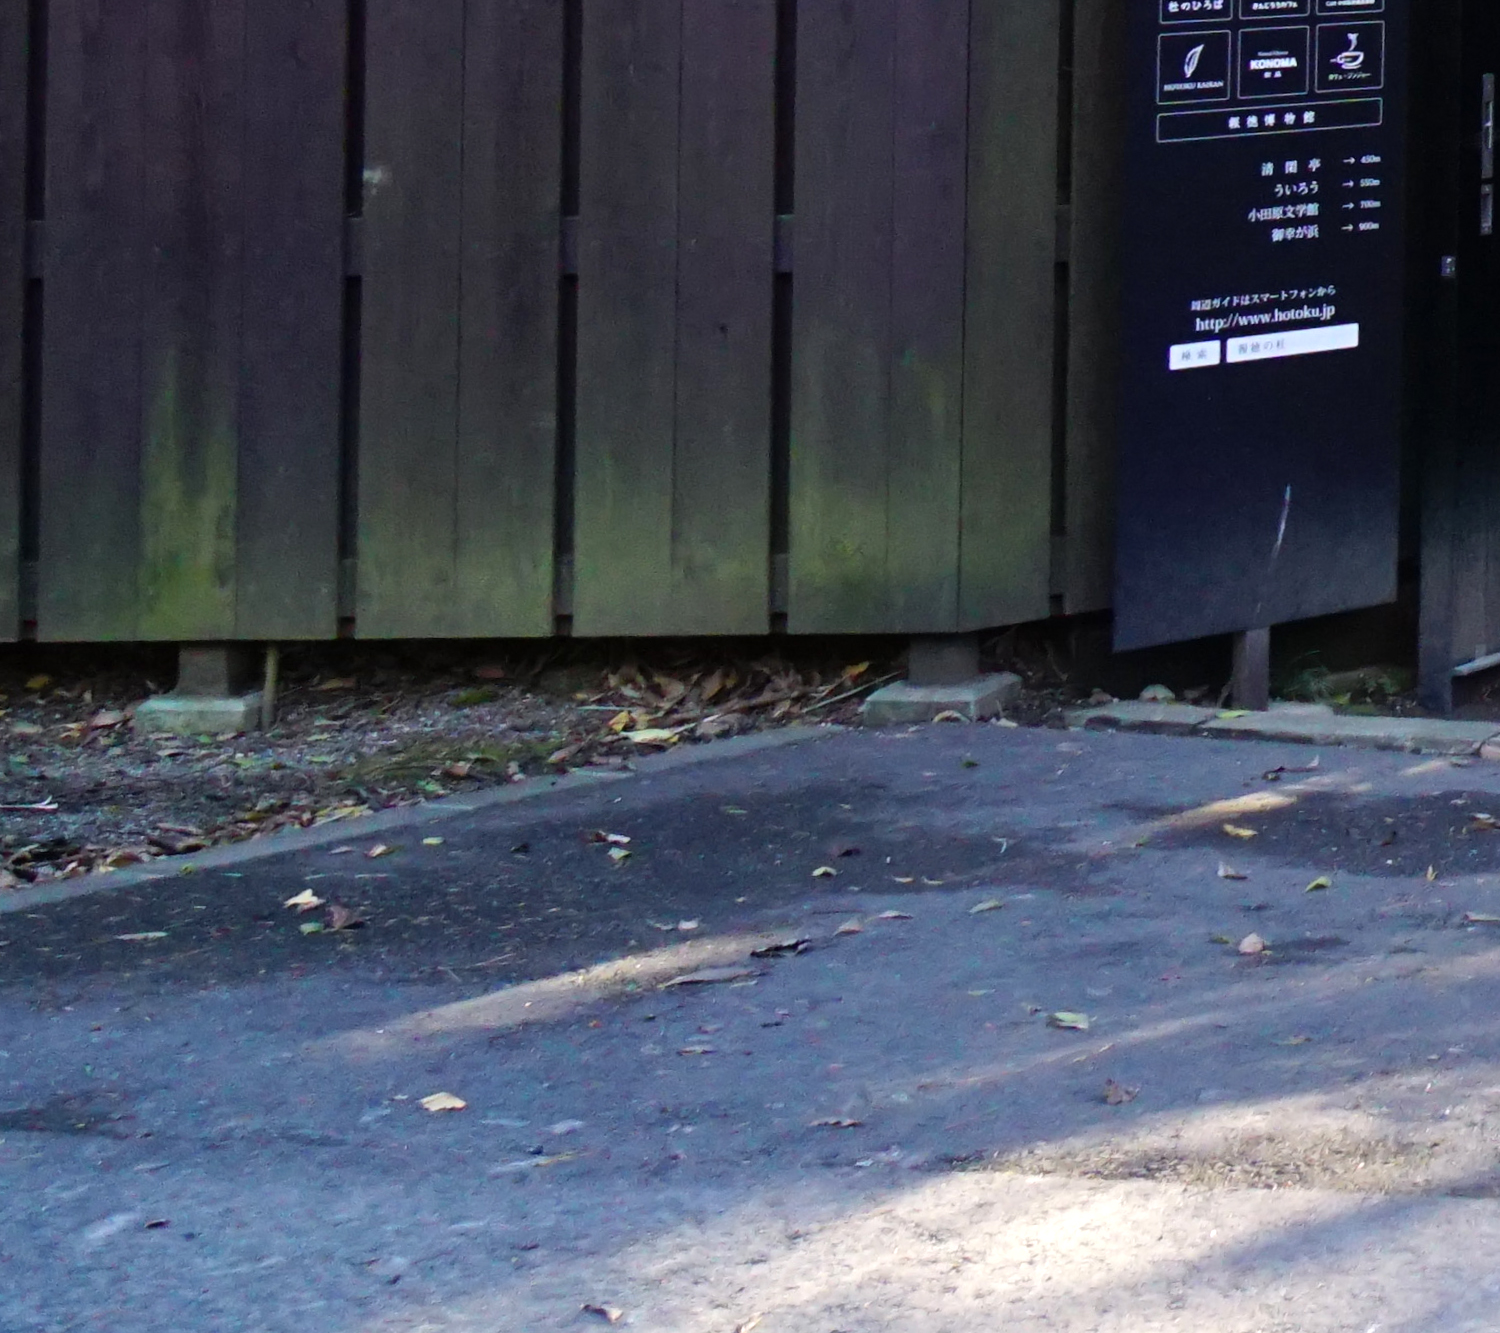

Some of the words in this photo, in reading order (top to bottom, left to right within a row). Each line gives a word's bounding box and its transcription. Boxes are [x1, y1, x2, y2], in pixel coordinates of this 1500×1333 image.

[1249, 57, 1298, 70] KONOMA
[1274, 180, 1319, 198] ういろう
[1247, 202, 1320, 223] 小田原文学館
[1190, 284, 1337, 312] 周辺ガイドはスマートフォンから
[1195, 303, 1336, 333] http://www.hotoku.jp
